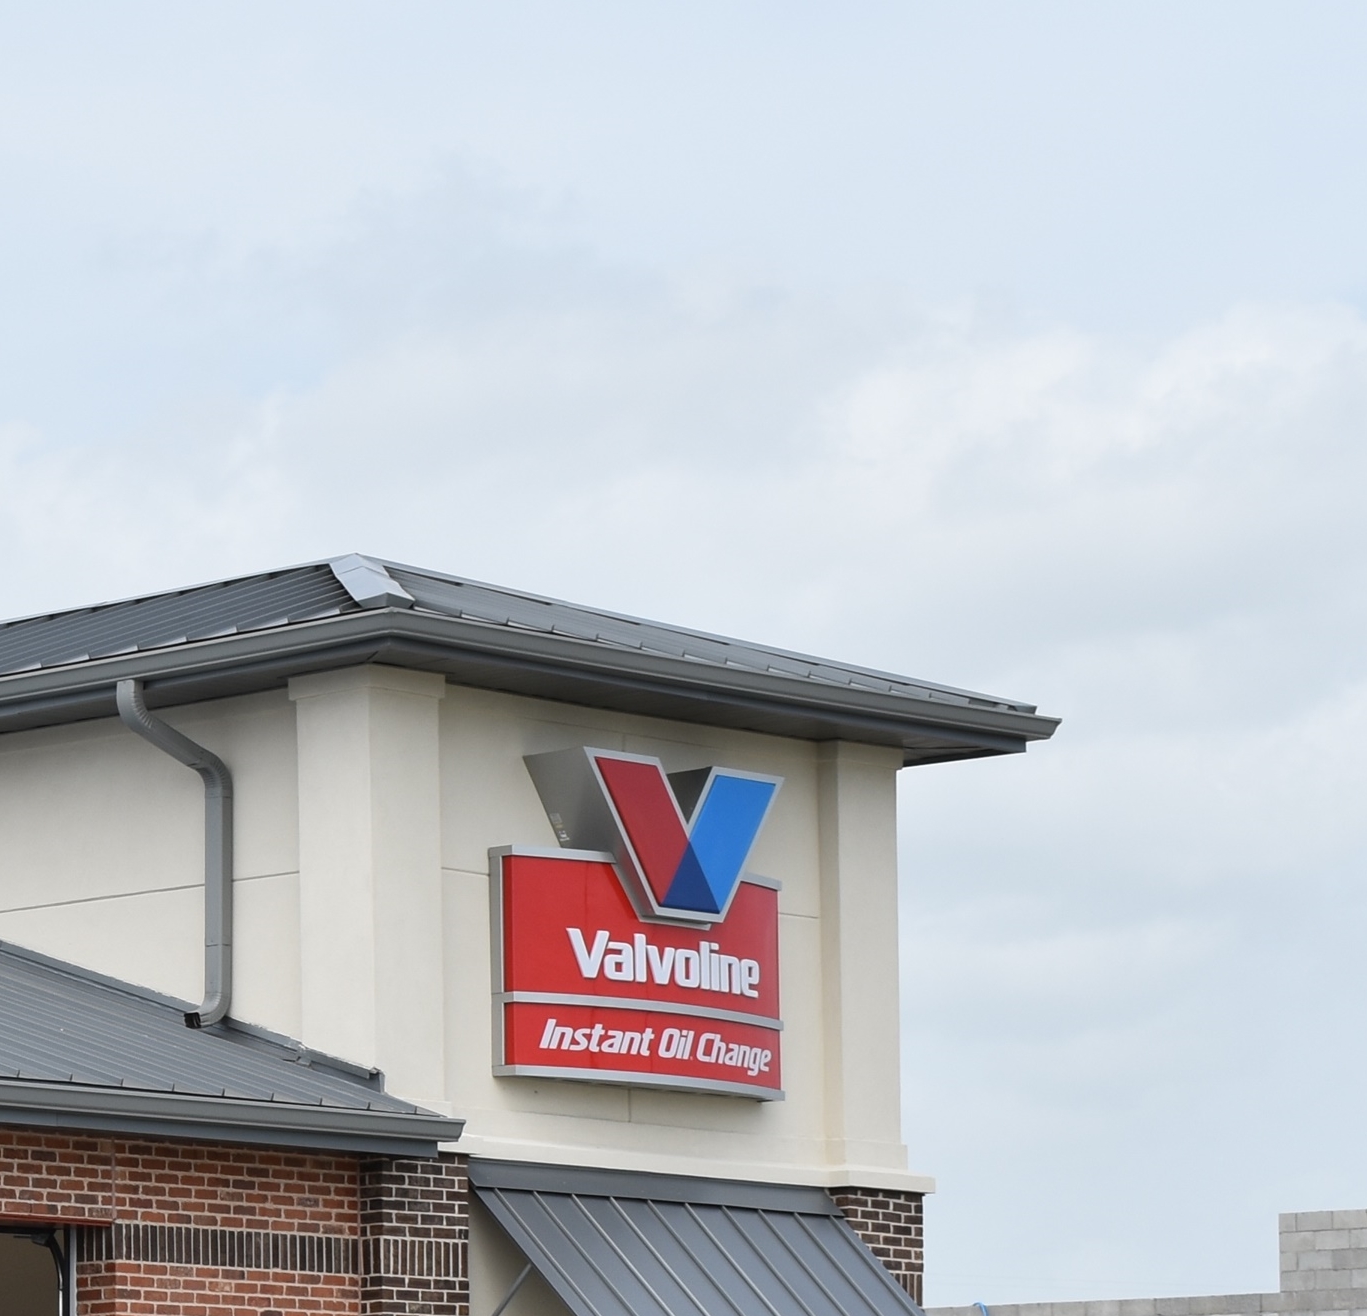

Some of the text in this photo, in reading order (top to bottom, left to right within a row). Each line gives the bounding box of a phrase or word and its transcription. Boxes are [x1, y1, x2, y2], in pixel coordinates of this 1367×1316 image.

[566, 927, 760, 998] Valvoline
[539, 1018, 772, 1076] Instant Oil Change
